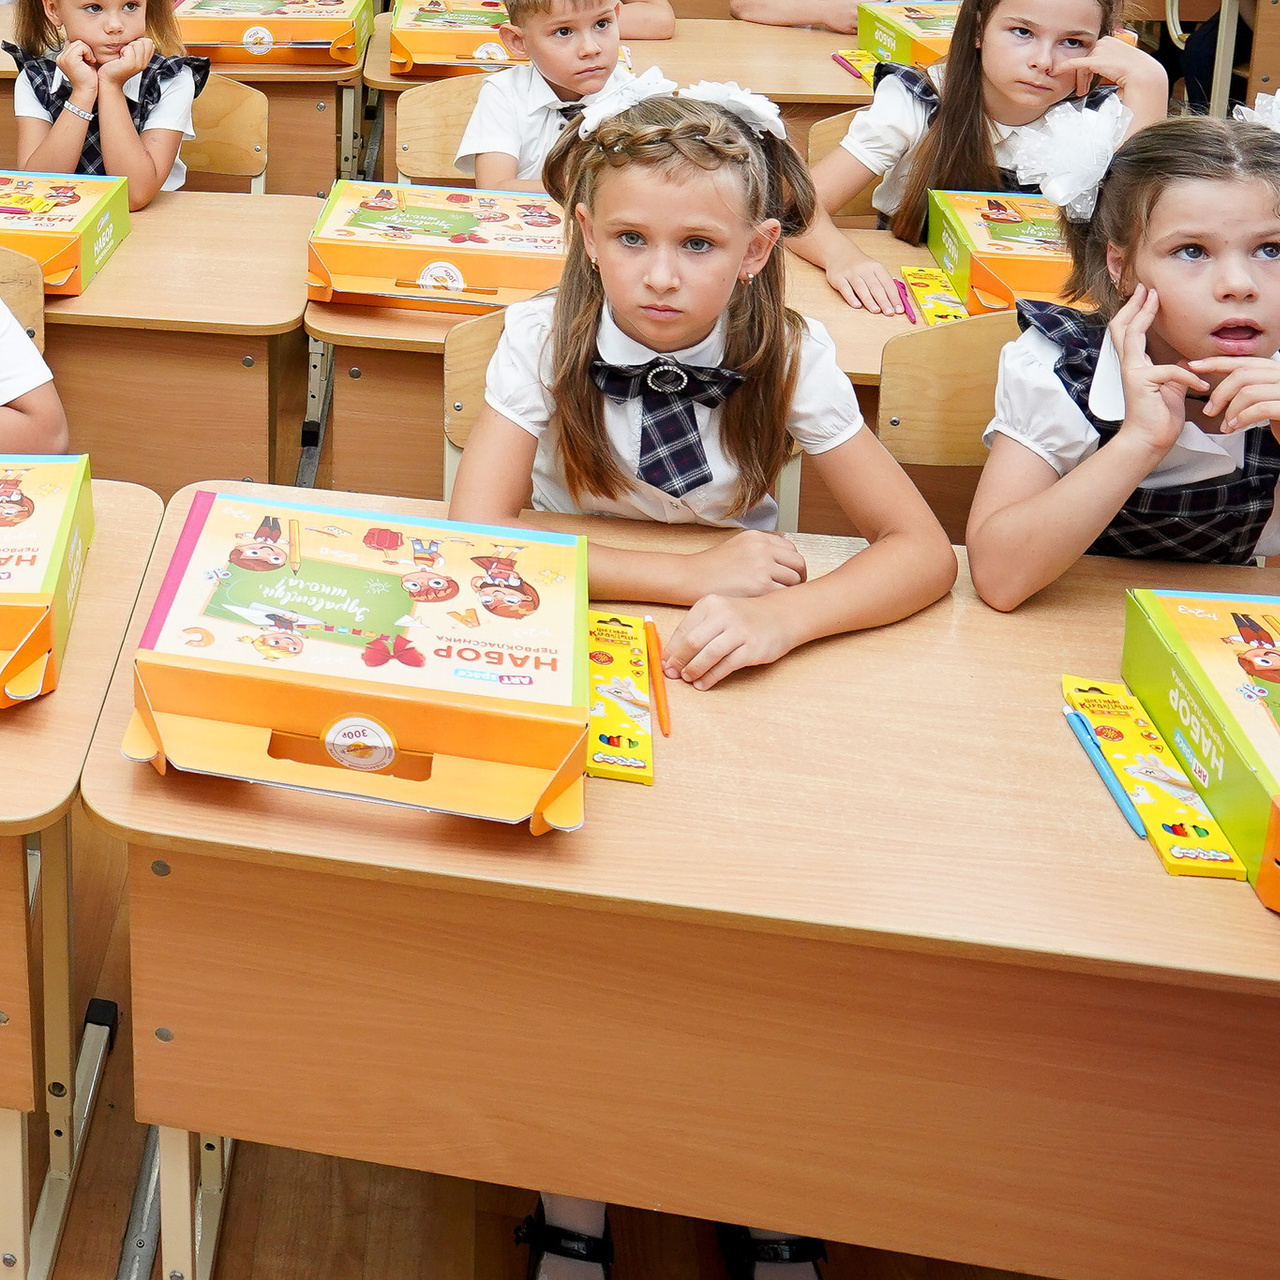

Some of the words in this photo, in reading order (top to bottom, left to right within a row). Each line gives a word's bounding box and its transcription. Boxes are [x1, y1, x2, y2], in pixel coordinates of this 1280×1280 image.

[4, 214, 74, 223] НАБОР
[436, 635, 558, 655] ПЕРВОКЛАССНИКА
[433, 645, 558, 672] НАБОР
[1169, 688, 1224, 781] НАБОР
